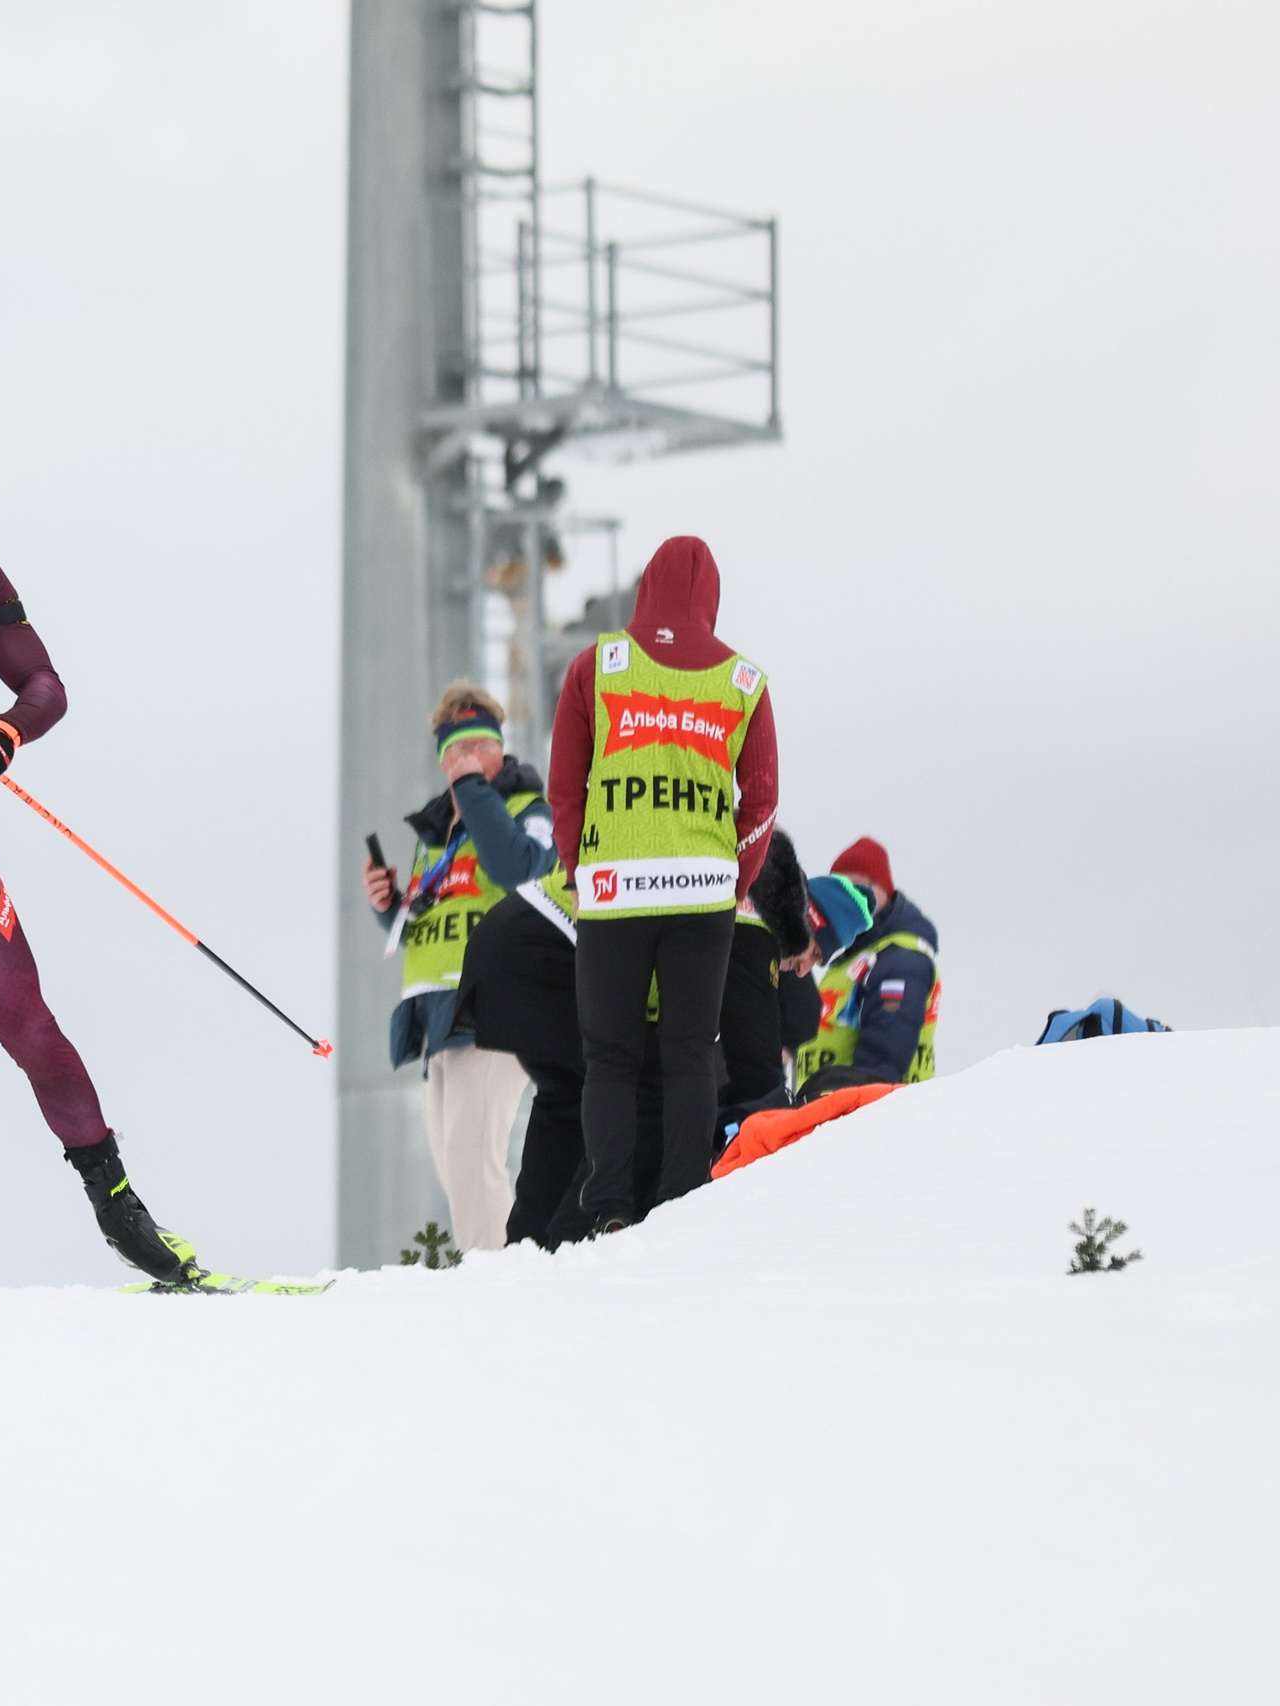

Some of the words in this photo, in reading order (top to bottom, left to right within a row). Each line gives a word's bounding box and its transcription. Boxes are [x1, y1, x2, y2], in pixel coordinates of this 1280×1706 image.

[620, 708, 677, 735] Альфа
[681, 710, 726, 741] Банк
[623, 872, 733, 892] ТЕХНОНИК
